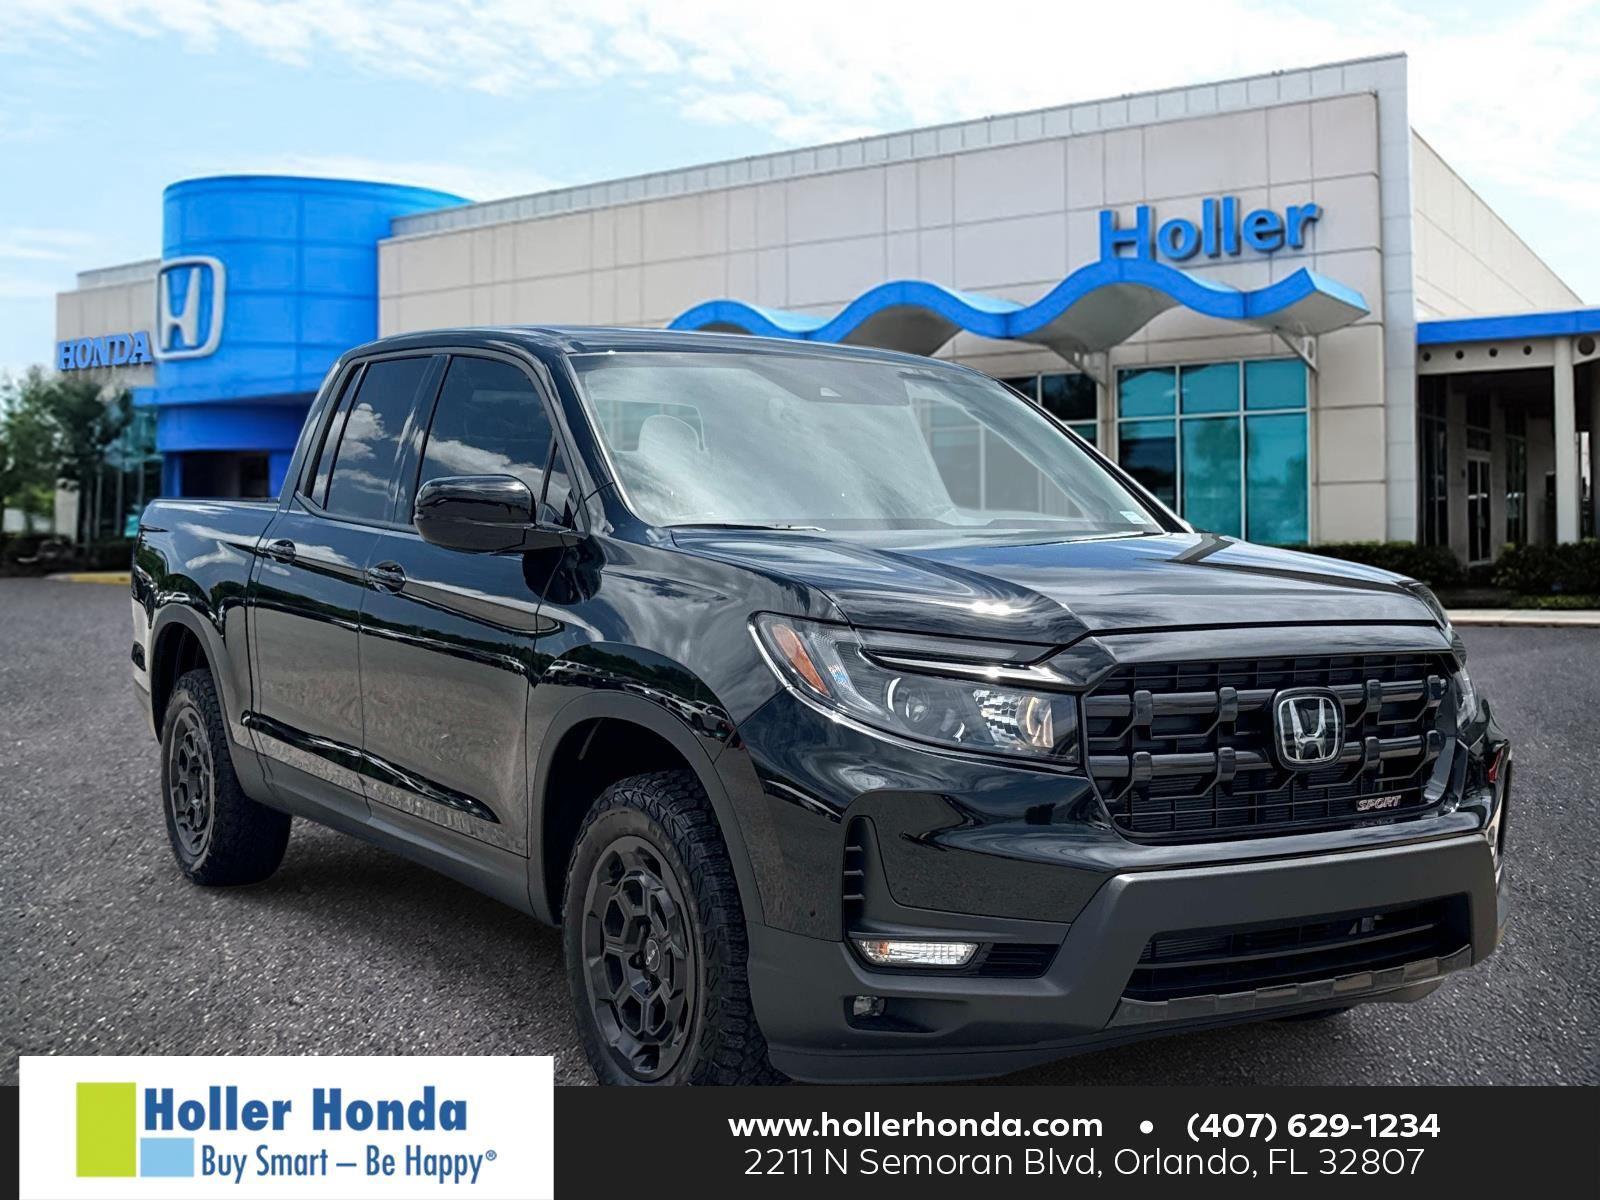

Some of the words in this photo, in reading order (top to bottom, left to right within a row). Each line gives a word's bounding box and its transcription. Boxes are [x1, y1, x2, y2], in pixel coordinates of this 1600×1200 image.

[1100, 196, 1321, 261] Holler
[58, 332, 153, 370] HONDA
[1356, 794, 1402, 812] SPORT
